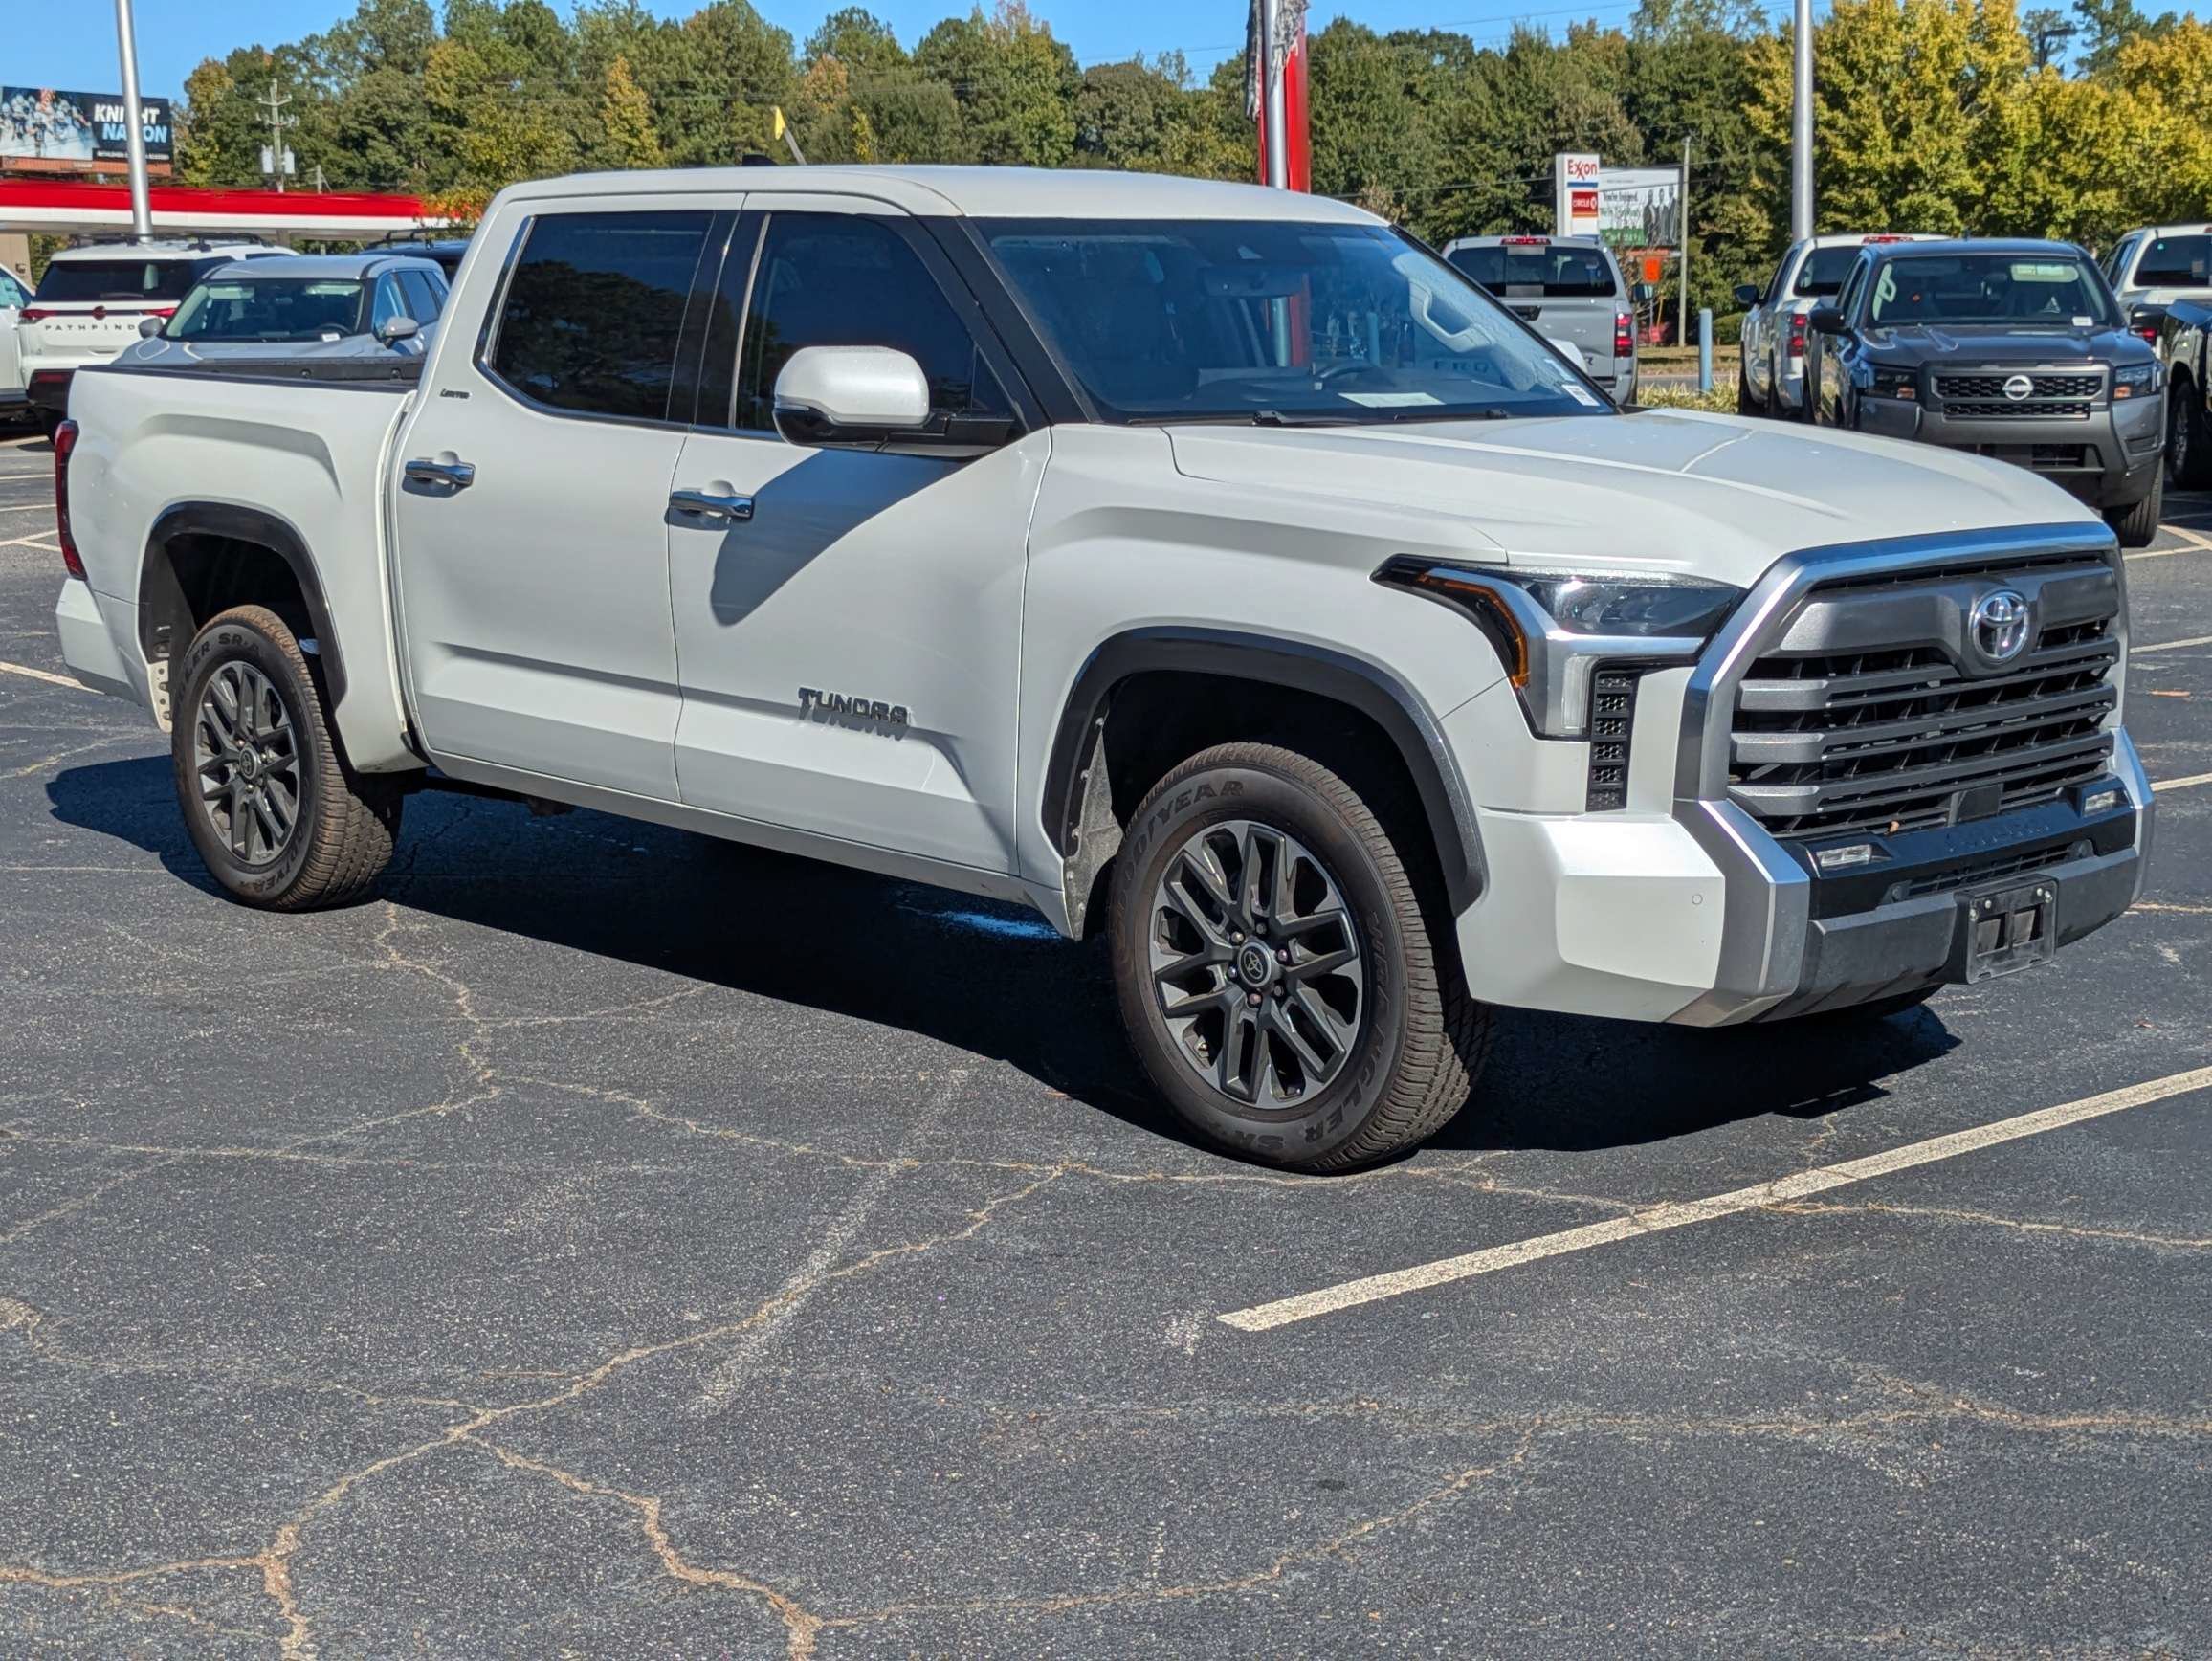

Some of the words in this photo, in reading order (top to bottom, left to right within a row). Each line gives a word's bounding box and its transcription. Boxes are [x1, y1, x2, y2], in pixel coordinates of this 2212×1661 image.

[94, 103, 160, 124] KNIHT
[102, 122, 167, 144] NAON
[1567, 159, 1598, 181] Exxon
[799, 687, 909, 726] TUNDRA
[1117, 780, 1244, 938] OODYEAR
